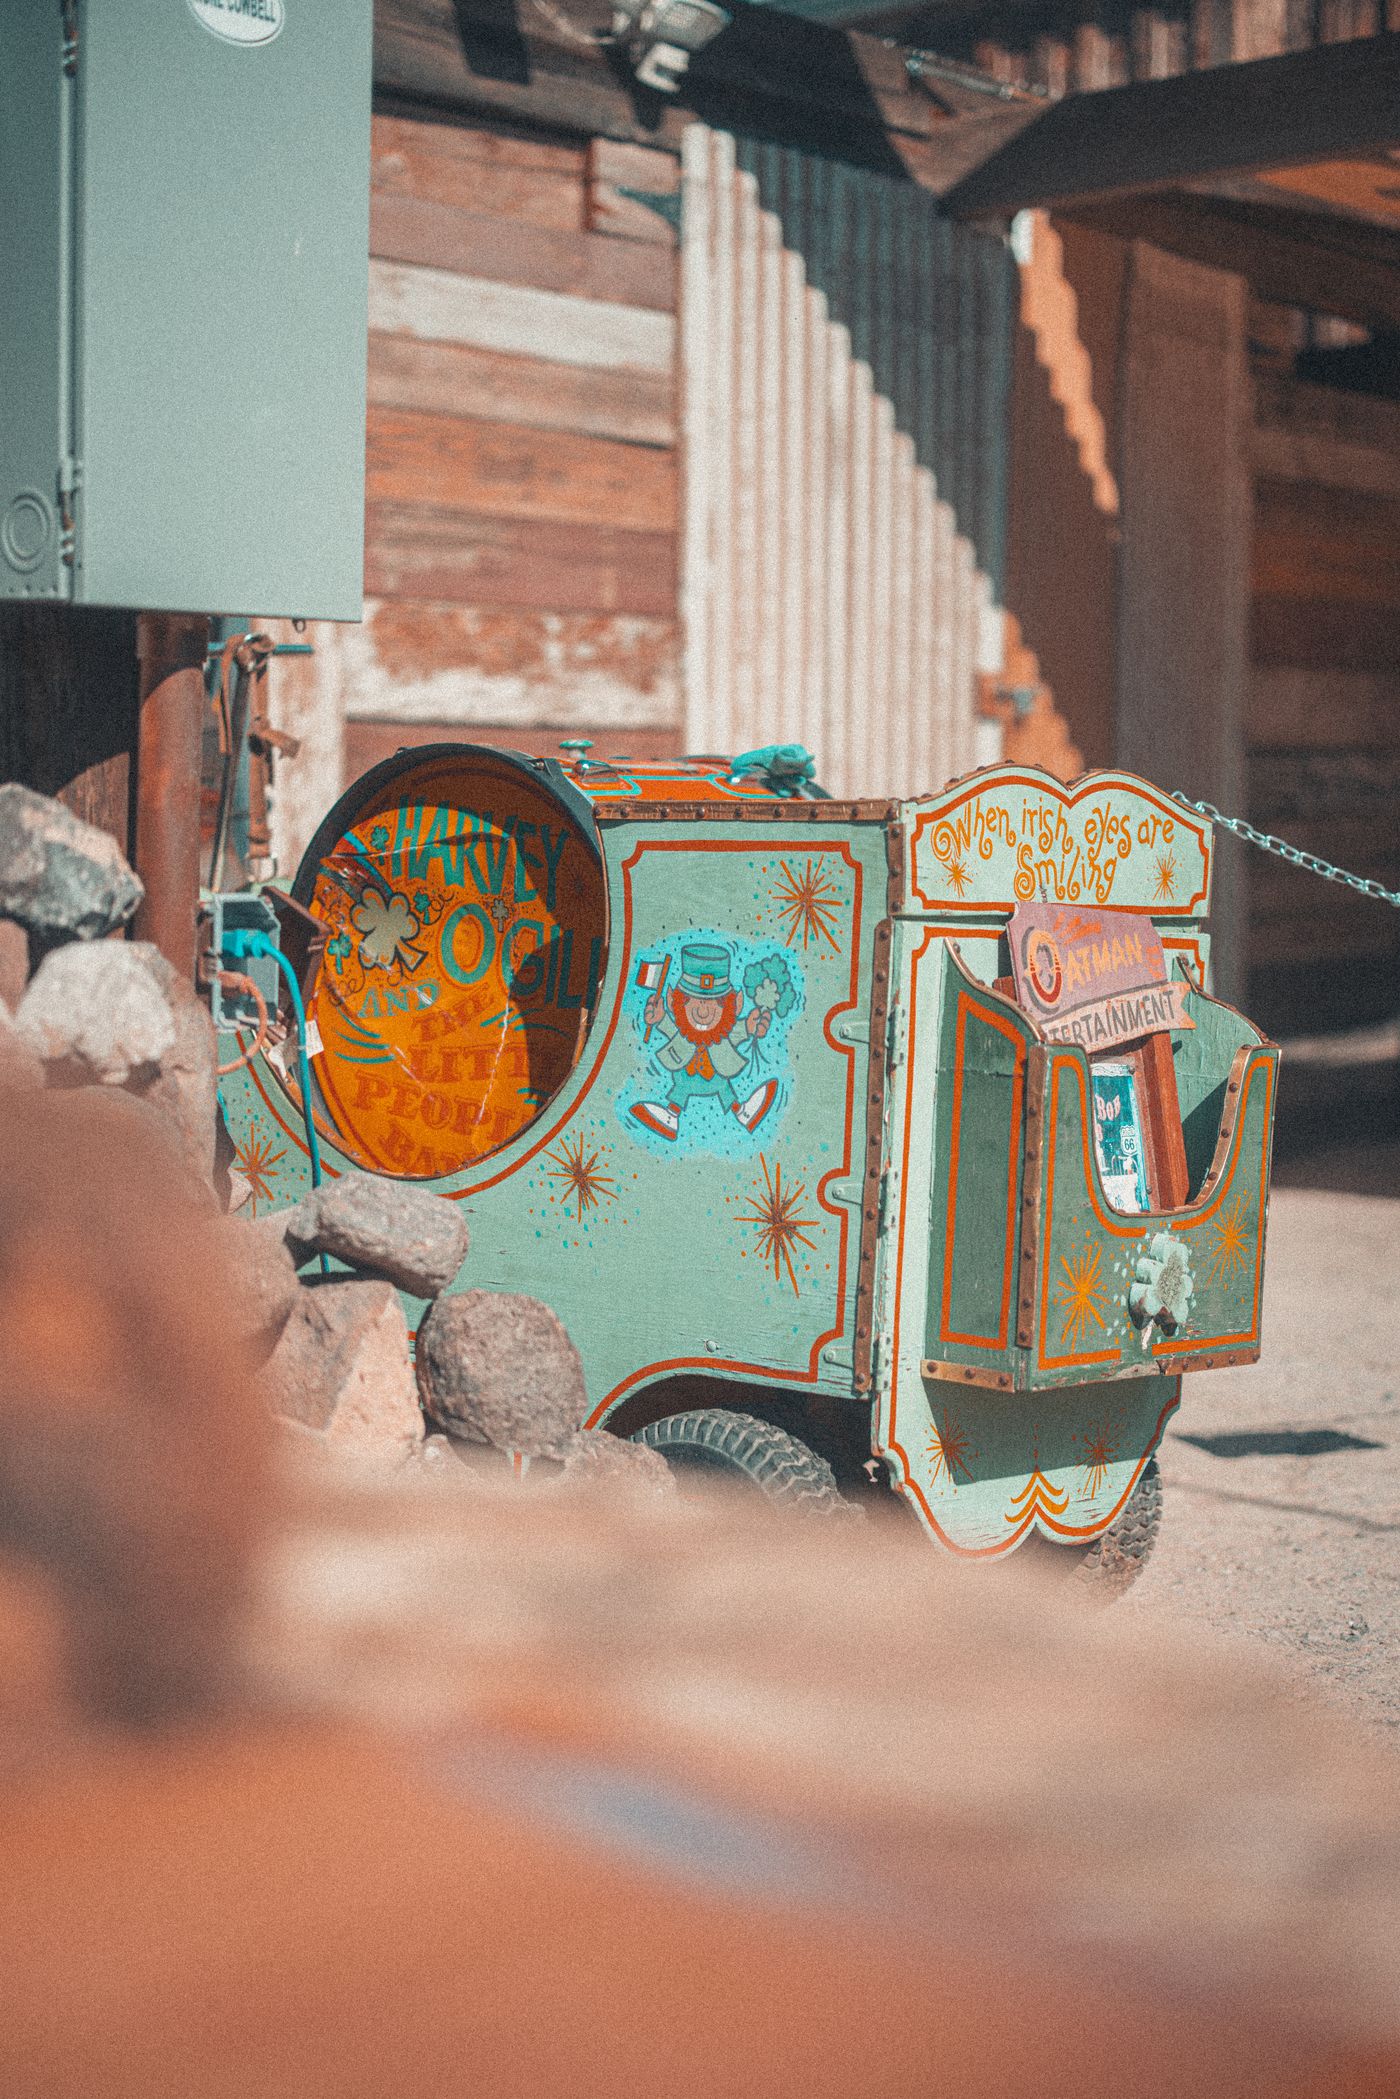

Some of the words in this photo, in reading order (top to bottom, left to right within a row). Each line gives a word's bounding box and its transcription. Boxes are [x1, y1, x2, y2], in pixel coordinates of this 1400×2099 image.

[390, 795, 569, 913] HARVEY
[931, 798, 1016, 862] When
[1022, 798, 1074, 855] irish
[1084, 801, 1133, 860] eyes
[1138, 814, 1176, 849] are
[1013, 841, 1119, 904] Smiling
[1023, 926, 1144, 1008] OATMAN
[357, 979, 442, 1019] AND
[410, 986, 495, 1043] THE
[1047, 990, 1176, 1047] TERTAINMENT
[408, 1041, 531, 1084] LITT
[353, 1070, 526, 1144] PEOPL
[1124, 1138, 1135, 1150] 66
